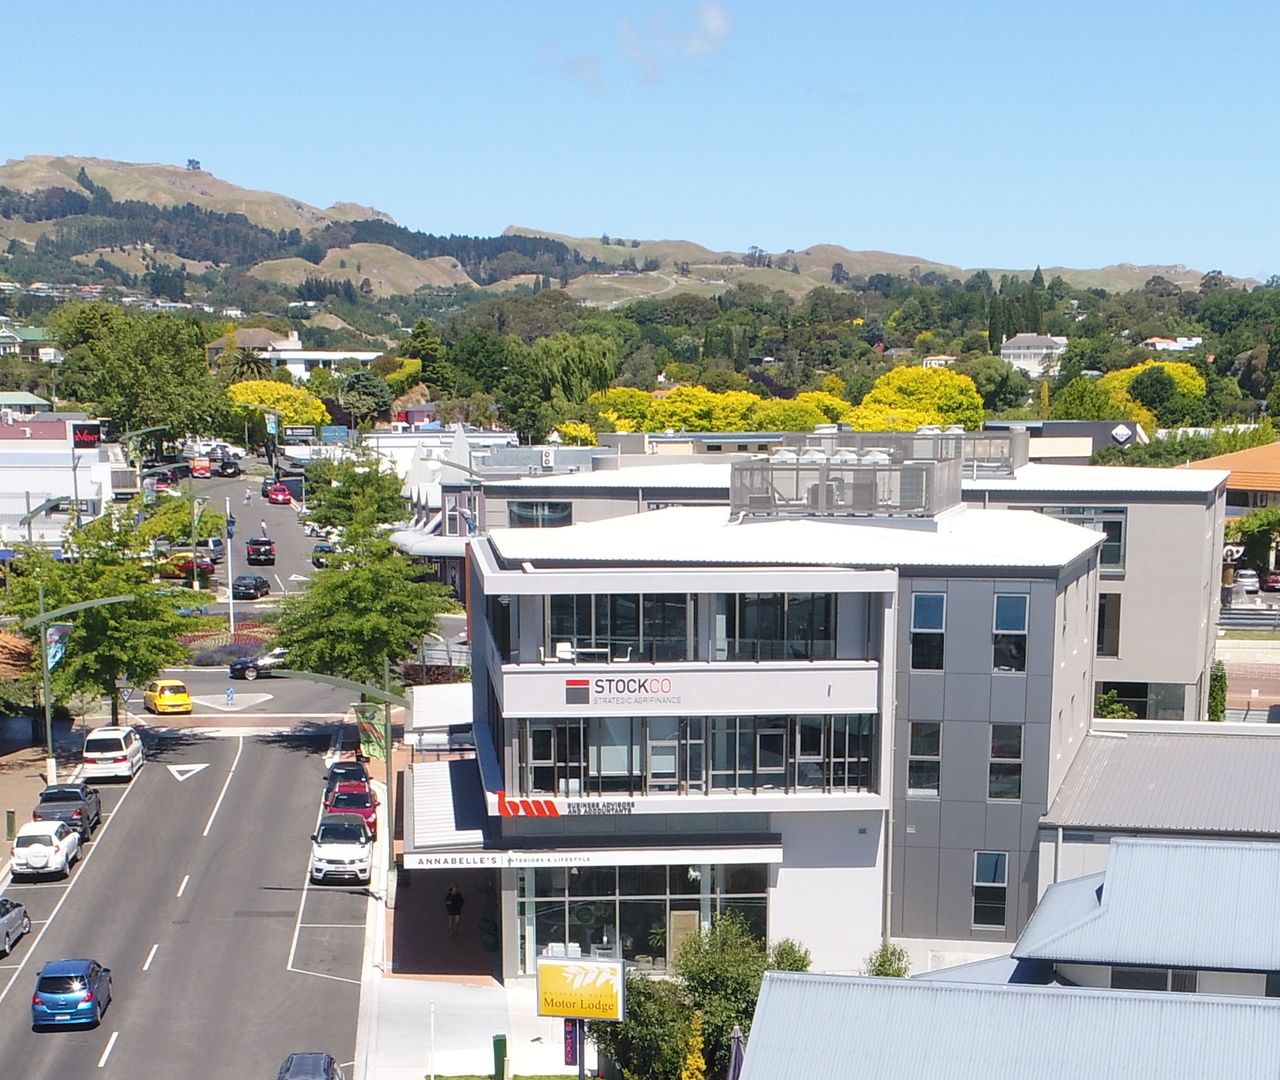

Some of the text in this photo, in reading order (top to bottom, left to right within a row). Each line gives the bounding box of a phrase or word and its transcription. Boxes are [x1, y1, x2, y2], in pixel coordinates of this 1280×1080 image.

[594, 678, 672, 694] STOCKCO
[417, 856, 498, 865] ANNABELLE'S
[543, 997, 614, 1012] Motor Lodge
